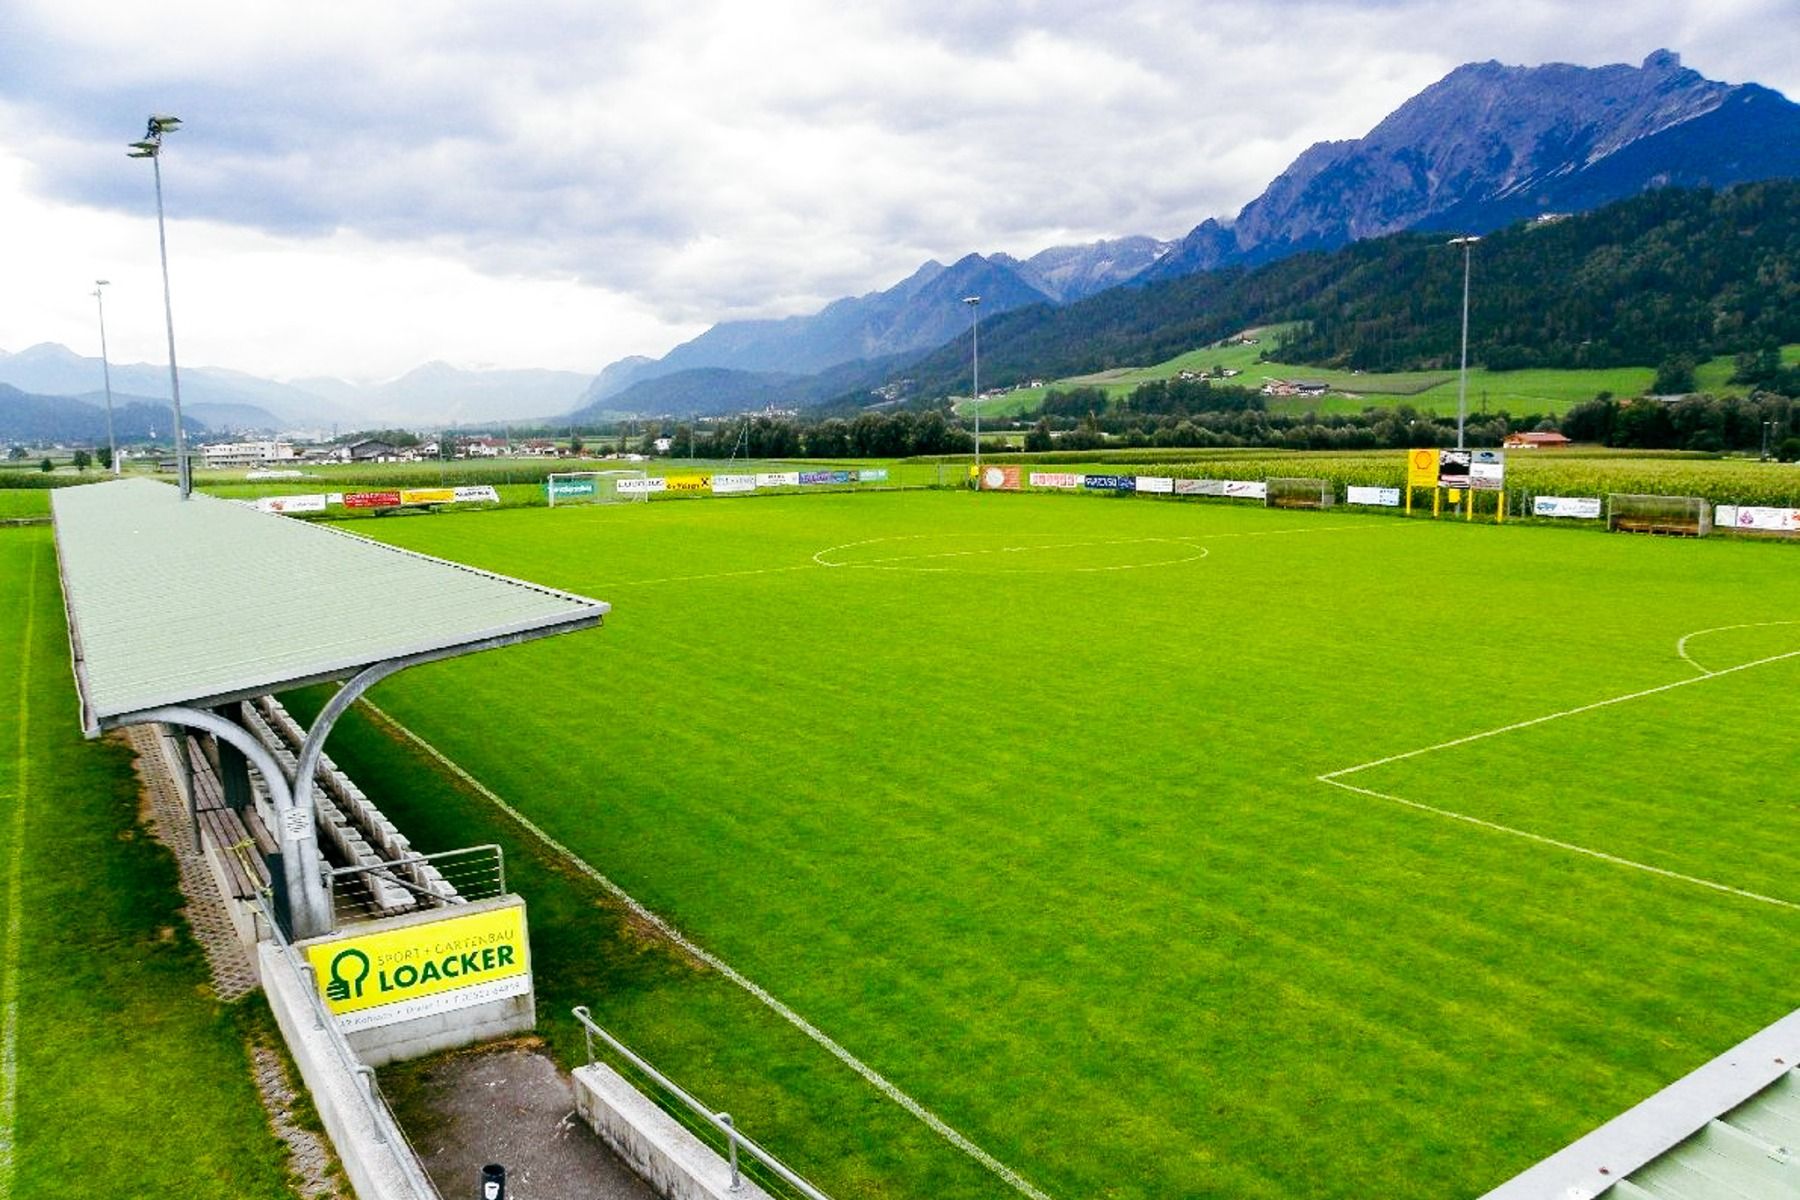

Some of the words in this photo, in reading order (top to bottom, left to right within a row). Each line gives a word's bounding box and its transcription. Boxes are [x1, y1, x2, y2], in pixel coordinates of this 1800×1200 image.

[378, 948, 419, 966] SPORT
[435, 930, 514, 954] GARTENBAU
[380, 945, 515, 992] LOACKER
